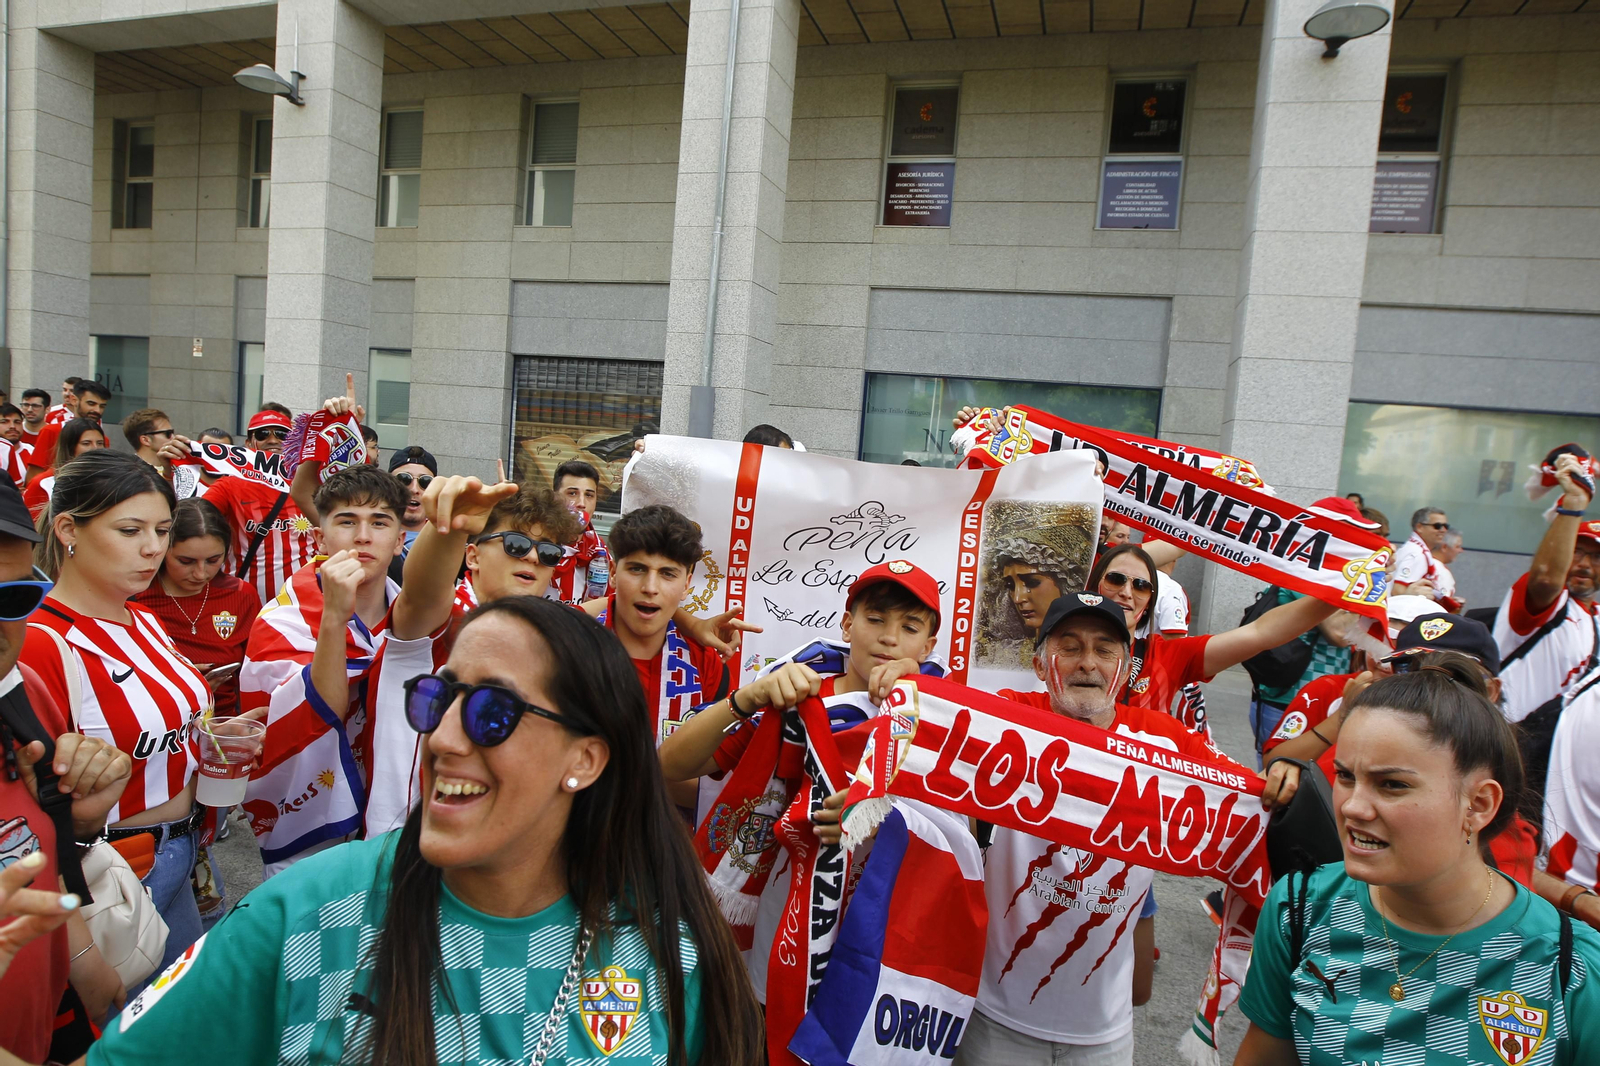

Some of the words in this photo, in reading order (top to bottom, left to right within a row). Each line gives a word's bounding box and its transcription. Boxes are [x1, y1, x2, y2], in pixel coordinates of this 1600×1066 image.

[241, 468, 286, 488] FUNDADA
[734, 496, 753, 530] UD
[1118, 462, 1332, 572] ALMERÍA
[959, 501, 982, 588] DESDE
[1148, 515, 1189, 542] nunca
[1191, 534, 1210, 549] se
[752, 559, 798, 586] La
[799, 609, 836, 629] del
[952, 598, 971, 671] 2013
[203, 763, 228, 774] Mahou
[923, 706, 1071, 826] LOS
[1106, 737, 1148, 761] PEÑA
[1152, 751, 1247, 790] ALMERIENSE
[1032, 866, 1081, 893] العربية
[1083, 883, 1130, 899] المراكز
[1029, 883, 1081, 910] Arabian
[1085, 899, 1126, 914] Centres
[777, 890, 802, 967] 2013
[584, 1001, 635, 1011] ALMERIA
[874, 993, 966, 1060] ORGUL
[1485, 1017, 1538, 1036] ALMERIA
